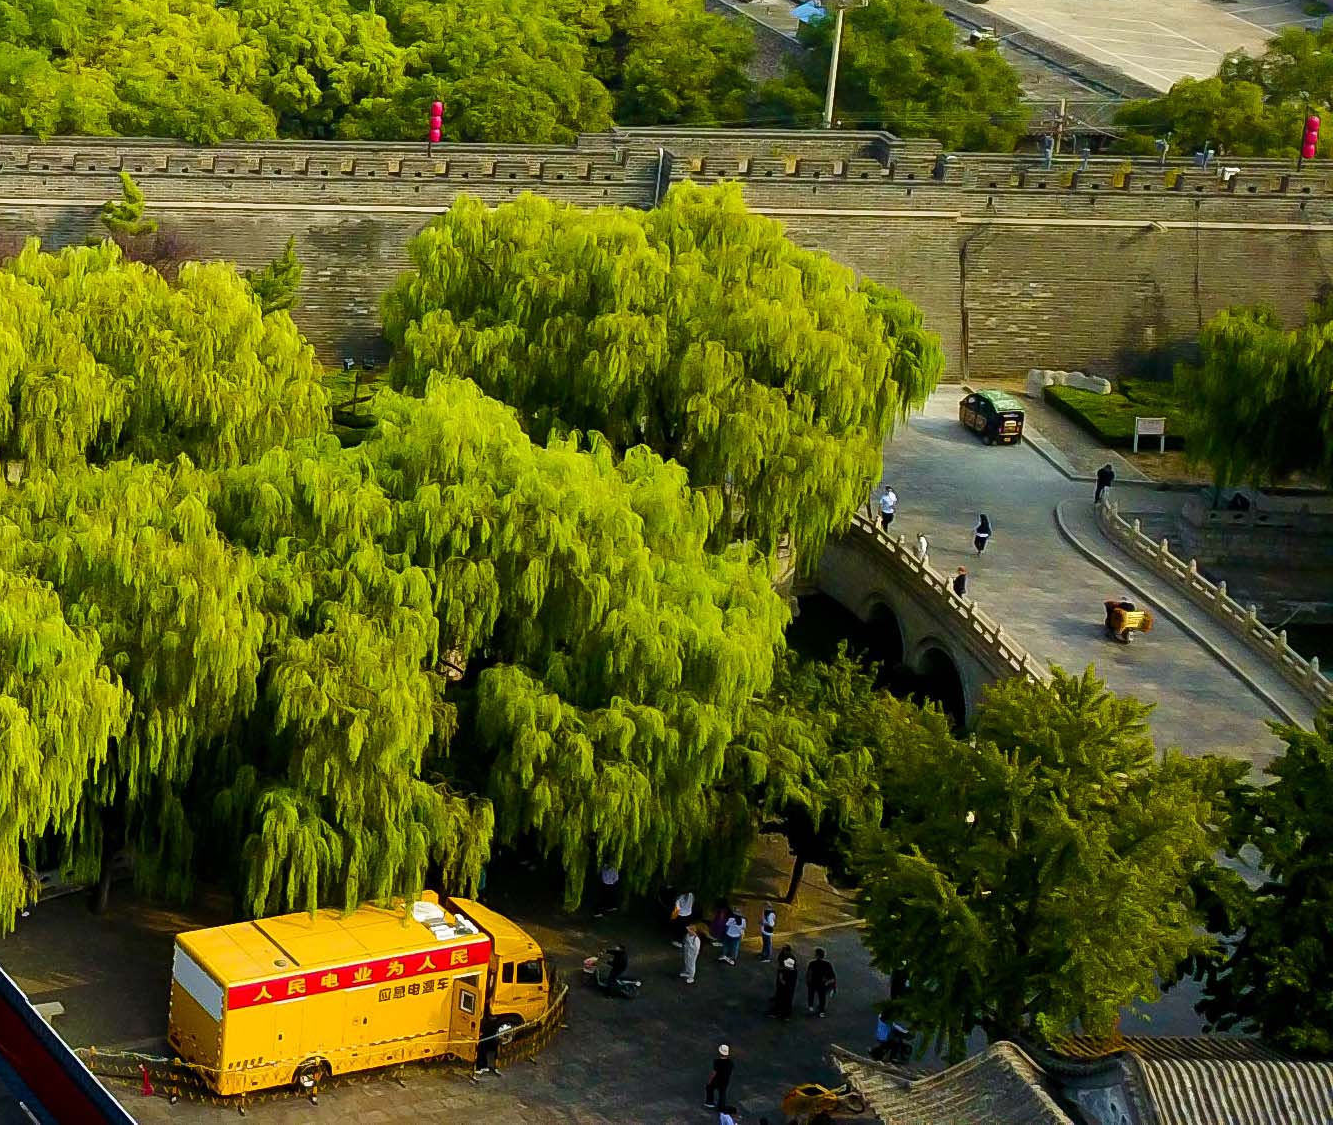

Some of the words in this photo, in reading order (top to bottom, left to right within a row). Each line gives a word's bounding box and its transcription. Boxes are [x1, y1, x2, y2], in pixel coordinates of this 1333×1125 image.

[252, 948, 469, 1003] 人民电业为人民
